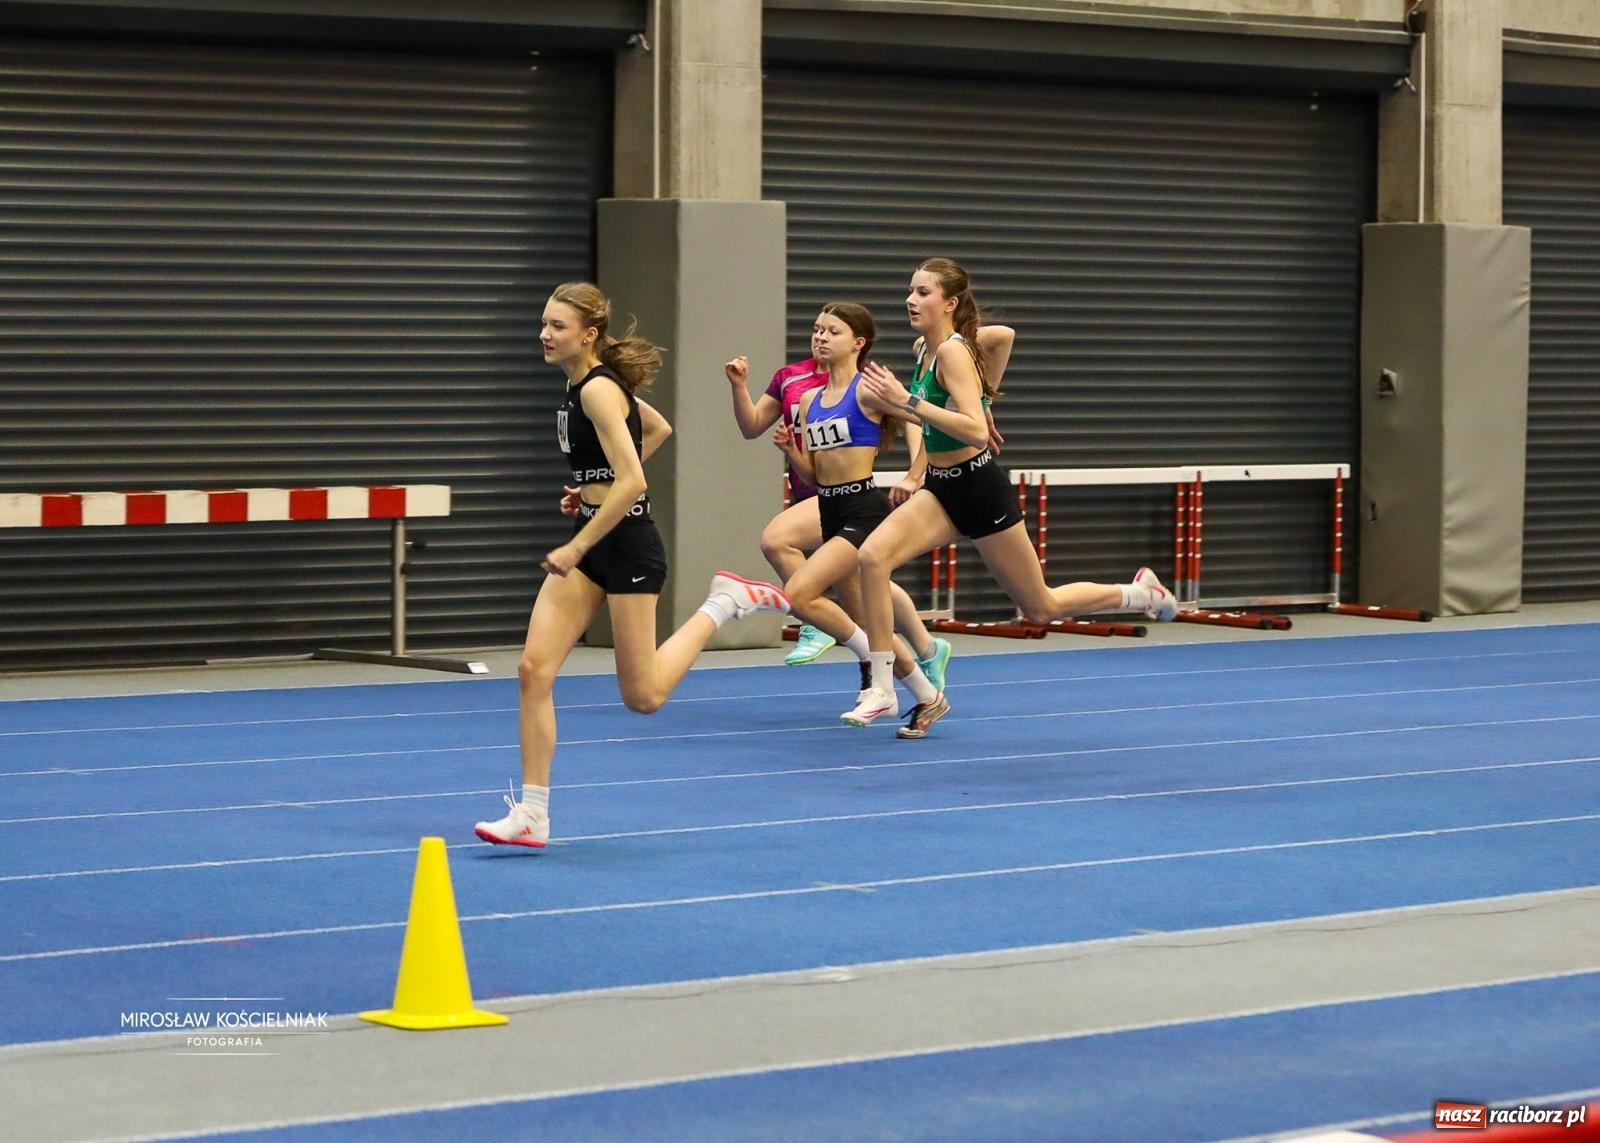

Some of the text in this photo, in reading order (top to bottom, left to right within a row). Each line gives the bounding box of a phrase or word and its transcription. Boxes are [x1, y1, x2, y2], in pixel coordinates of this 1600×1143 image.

[807, 423, 844, 448] 111
[932, 467, 962, 479] PRO
[970, 449, 992, 472] NIK
[832, 483, 862, 497] PRO
